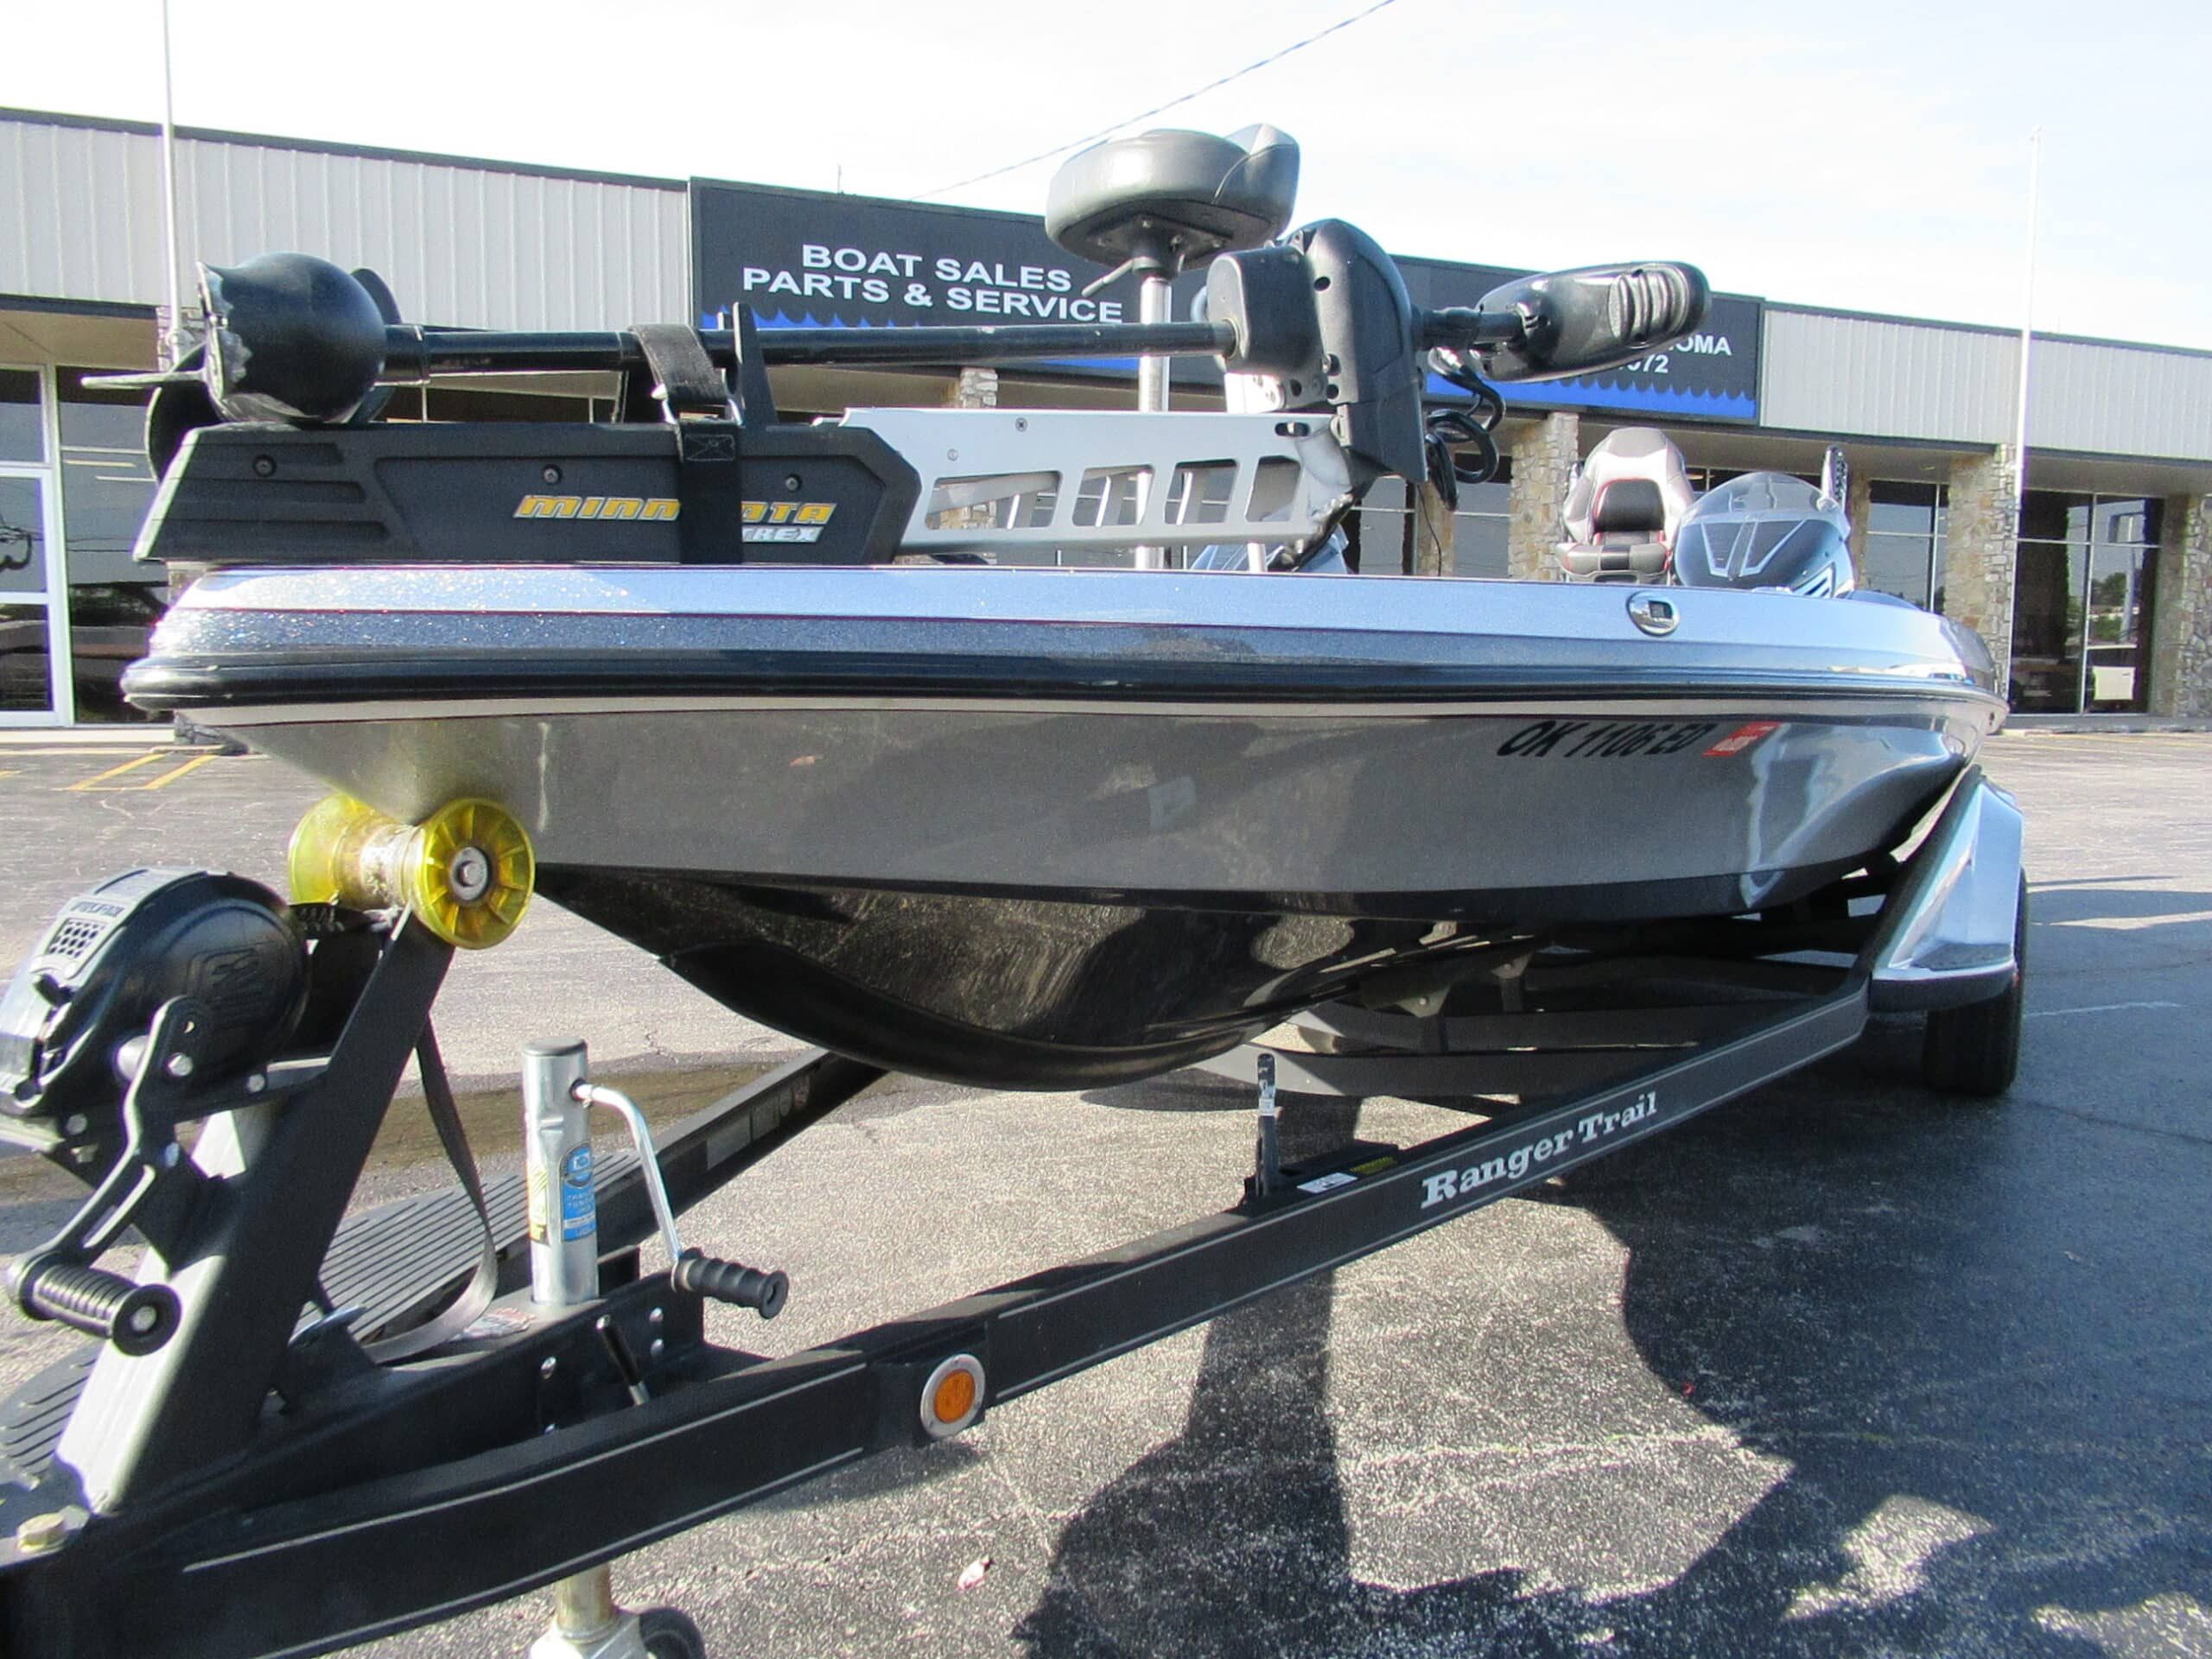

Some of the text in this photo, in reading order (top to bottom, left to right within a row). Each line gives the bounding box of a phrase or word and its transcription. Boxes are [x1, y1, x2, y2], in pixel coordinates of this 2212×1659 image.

[802, 244, 1071, 293] BOAT SALES
[742, 267, 1123, 324] PARTS & SERVICE
[1669, 334, 1732, 356] OMA
[741, 500, 837, 524] OTA
[1497, 720, 1590, 757] OK
[1421, 1091, 1657, 1209] Ranger Trail
